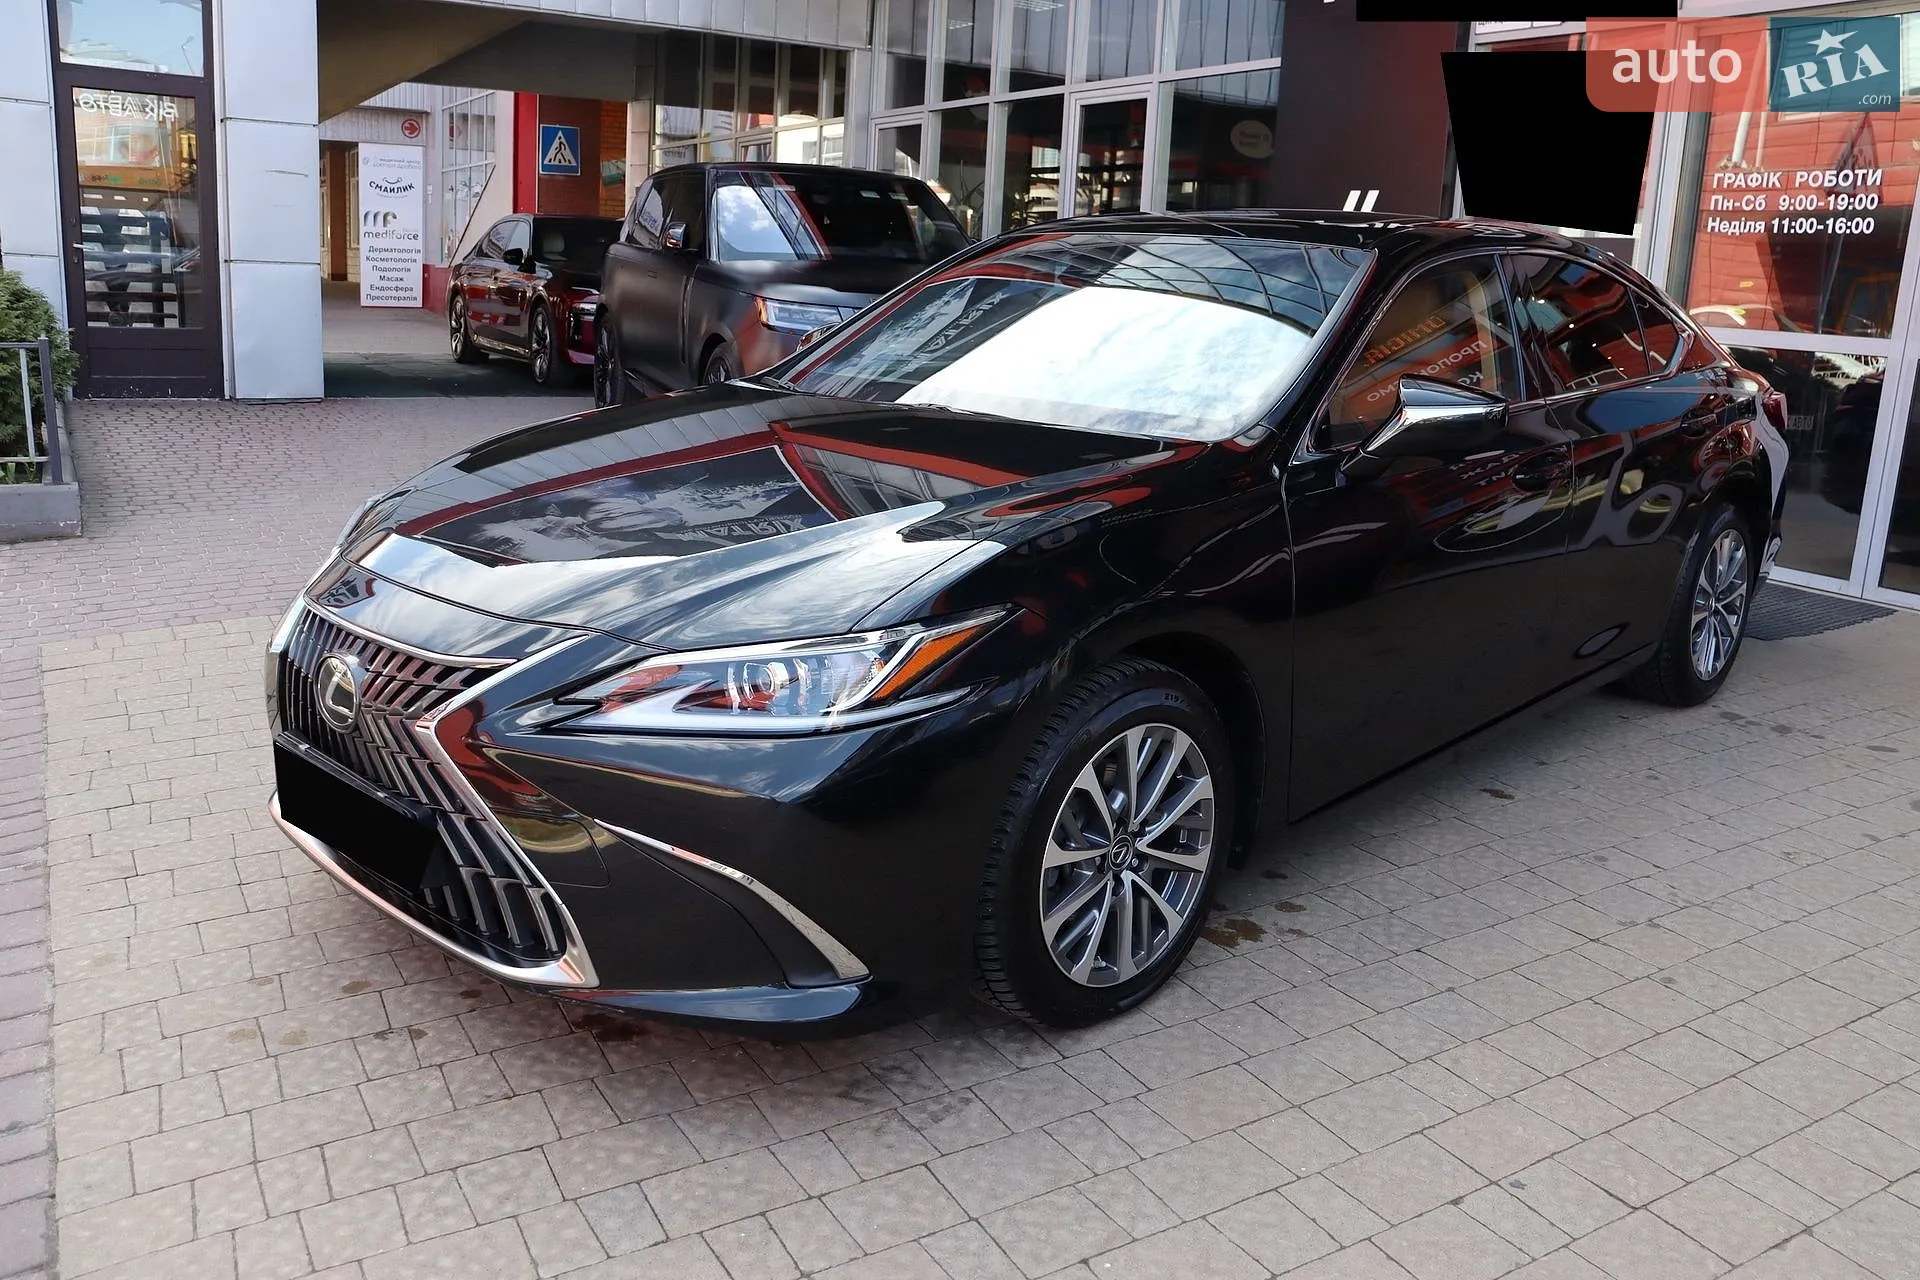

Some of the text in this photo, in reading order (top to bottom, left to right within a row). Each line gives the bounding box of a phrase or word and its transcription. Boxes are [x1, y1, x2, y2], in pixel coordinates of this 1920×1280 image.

[1712, 168, 1883, 188] ГРАФІК РОБОТИ
[1709, 193, 1879, 211] Пн-Сб 9:00-19:00
[364, 230, 418, 240] mediforce
[1707, 217, 1875, 235] Неділя 11:00-16:00
